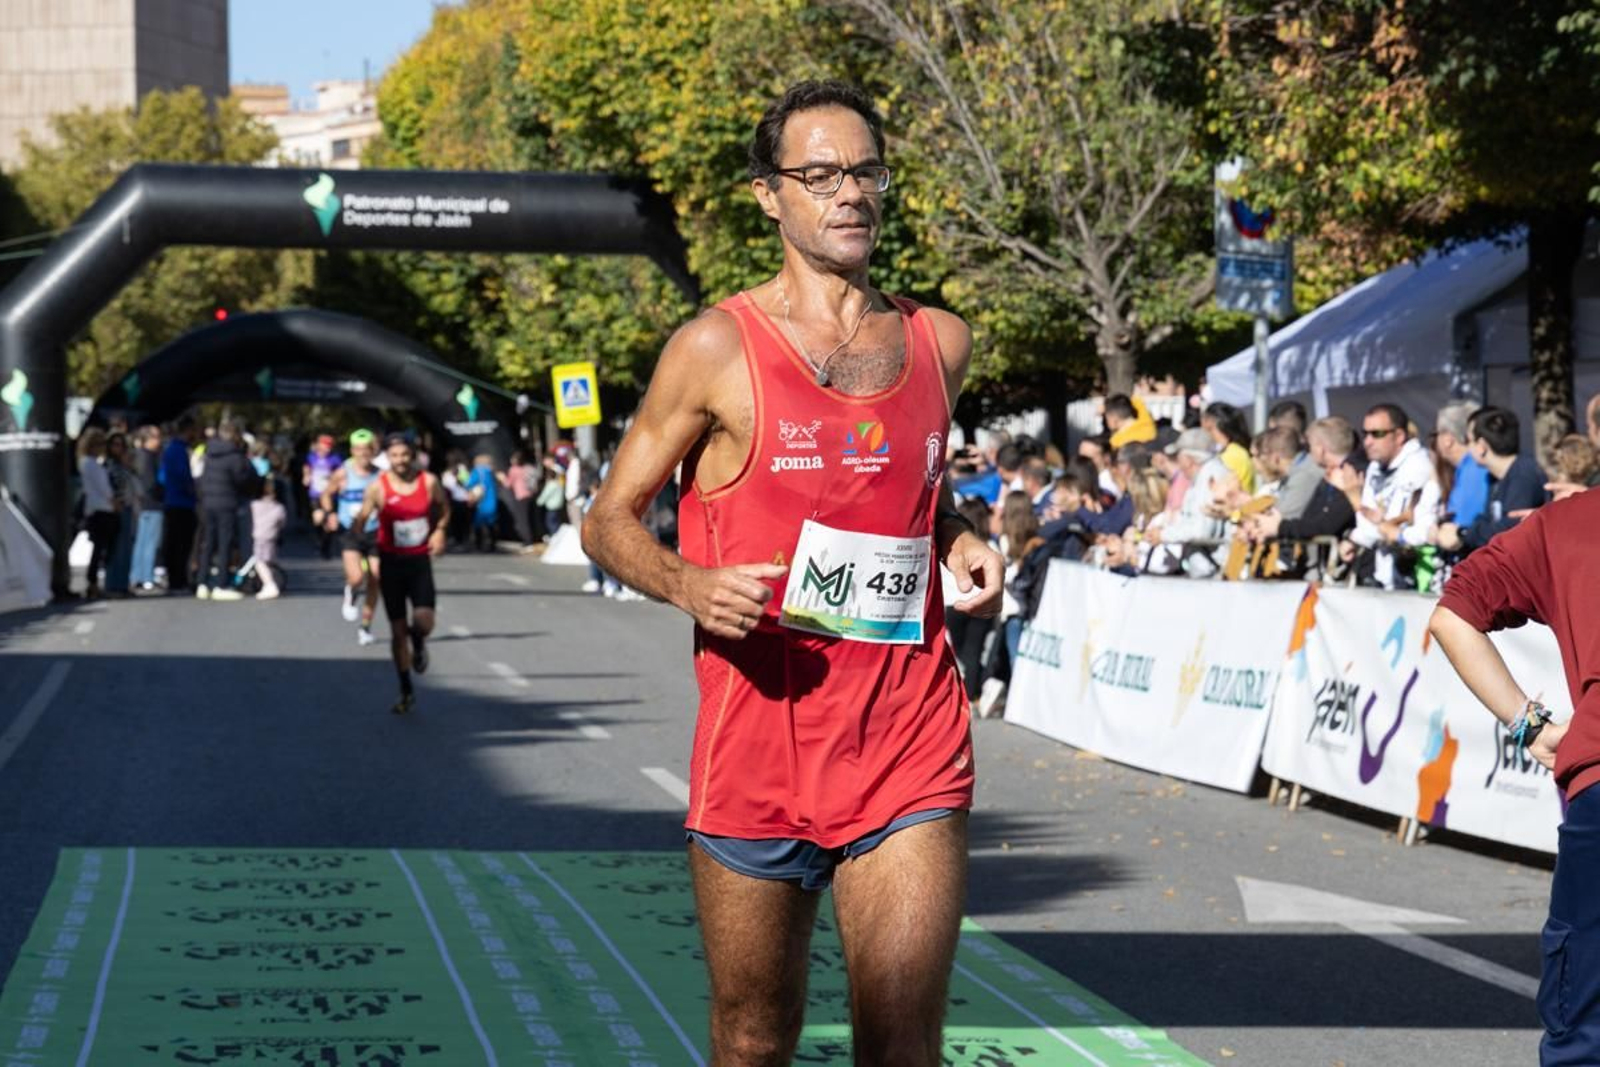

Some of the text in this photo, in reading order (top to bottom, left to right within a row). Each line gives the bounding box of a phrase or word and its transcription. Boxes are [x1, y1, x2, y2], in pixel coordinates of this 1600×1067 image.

[343, 194, 510, 213] Patronato Municipal de
[343, 210, 411, 227] Deportes
[412, 212, 433, 227] de
[866, 571, 918, 596] 438
